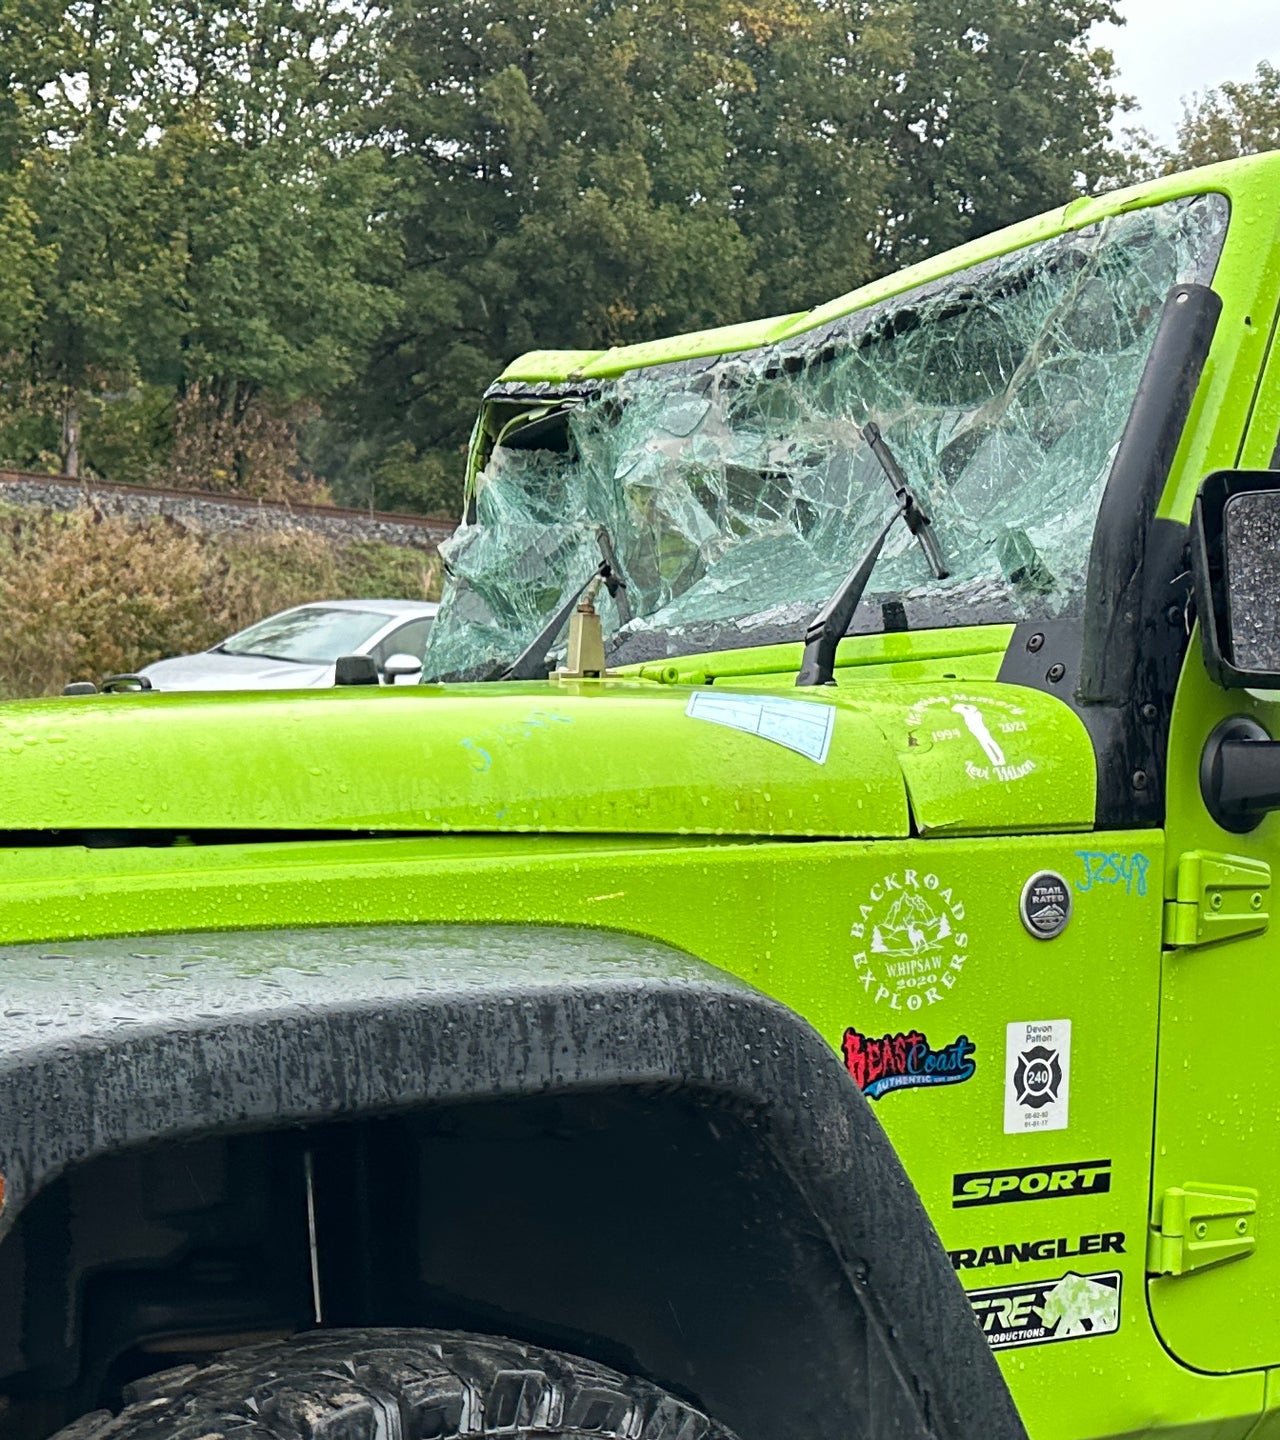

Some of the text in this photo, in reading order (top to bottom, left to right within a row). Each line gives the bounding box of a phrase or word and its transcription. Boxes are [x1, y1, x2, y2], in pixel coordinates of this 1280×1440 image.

[931, 728, 961, 743] 1994
[998, 720, 1028, 734] 2021
[1075, 850, 1151, 897] J2548
[1031, 894, 1065, 904] RATED
[1033, 886, 1064, 896] TRAIL
[884, 955, 943, 978] WHIPSAW
[895, 973, 938, 992] 2020
[1025, 1024, 1053, 1034] Devon
[844, 1030, 974, 1090] BEAST Coast
[875, 1074, 932, 1095] AUTHENTIC
[1028, 1070, 1049, 1085] 240
[953, 1166, 1113, 1202] SPORT
[946, 1231, 1127, 1270] RANGLER
[971, 1293, 1037, 1332] TRE
[987, 1326, 1046, 1344] RODUCTIONS
